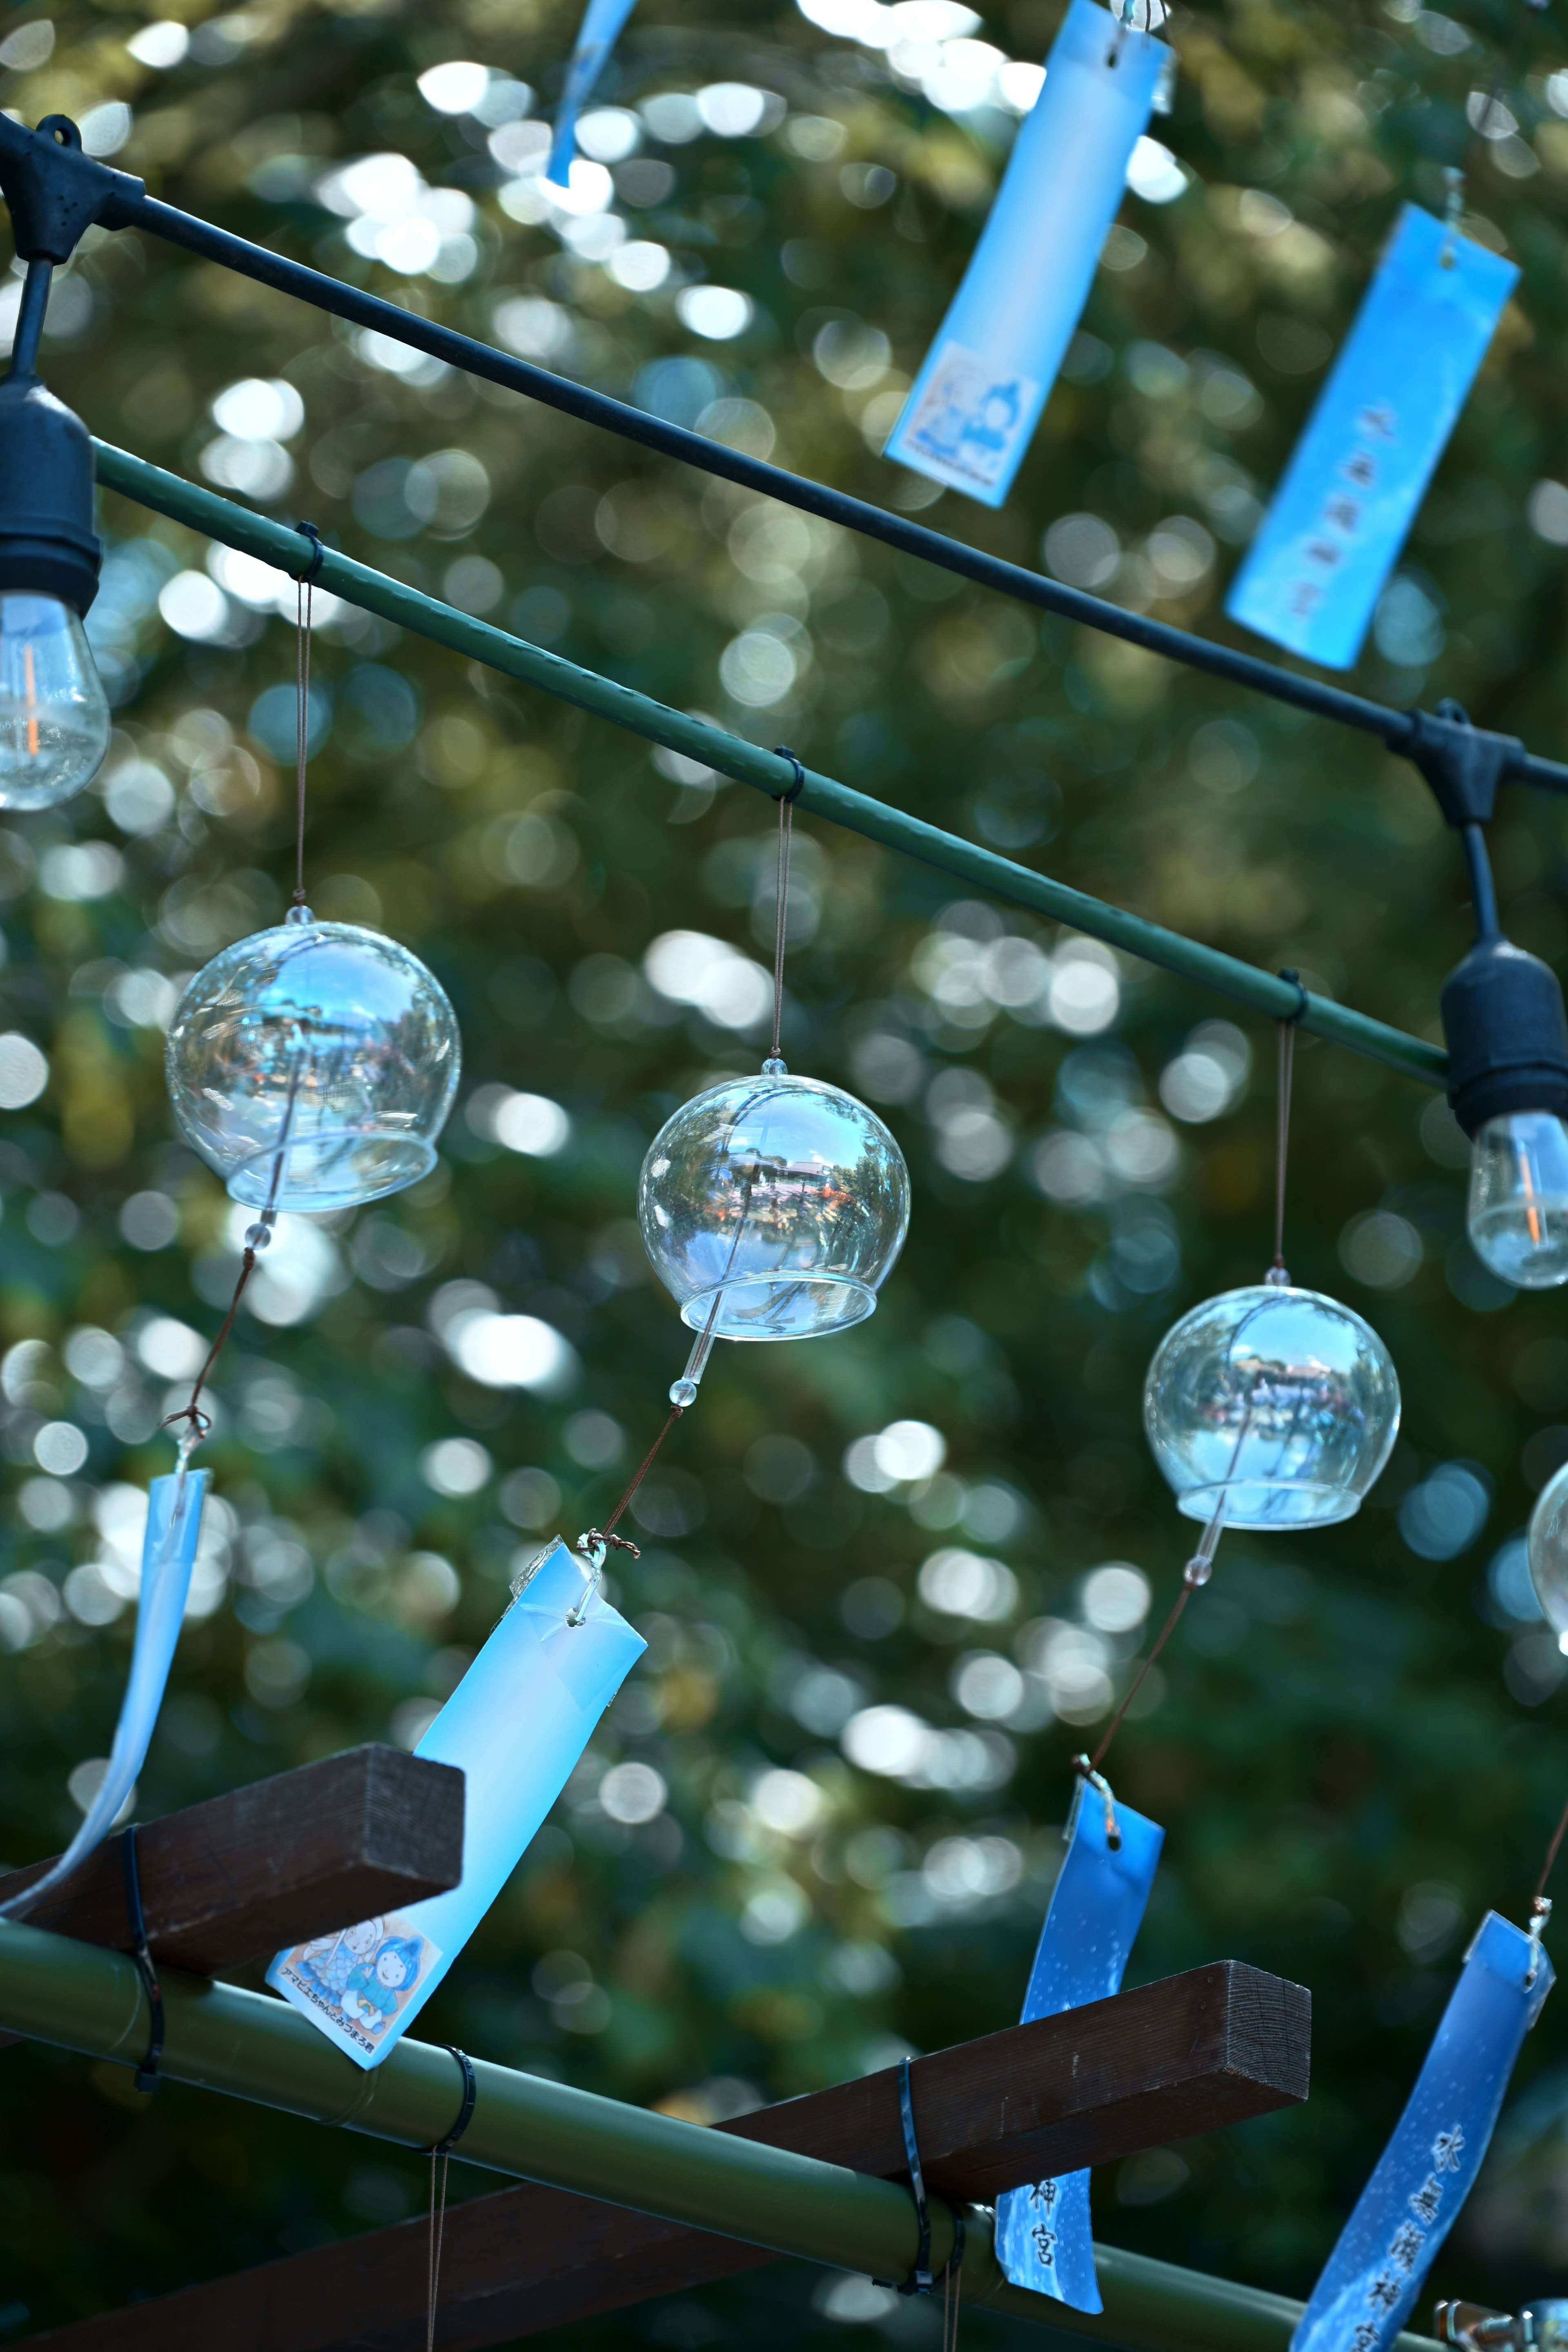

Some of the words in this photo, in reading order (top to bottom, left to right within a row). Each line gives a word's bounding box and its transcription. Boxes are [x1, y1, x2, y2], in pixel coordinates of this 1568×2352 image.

[281, 1967, 375, 2054] アマビエちゃんとみづまろ君
